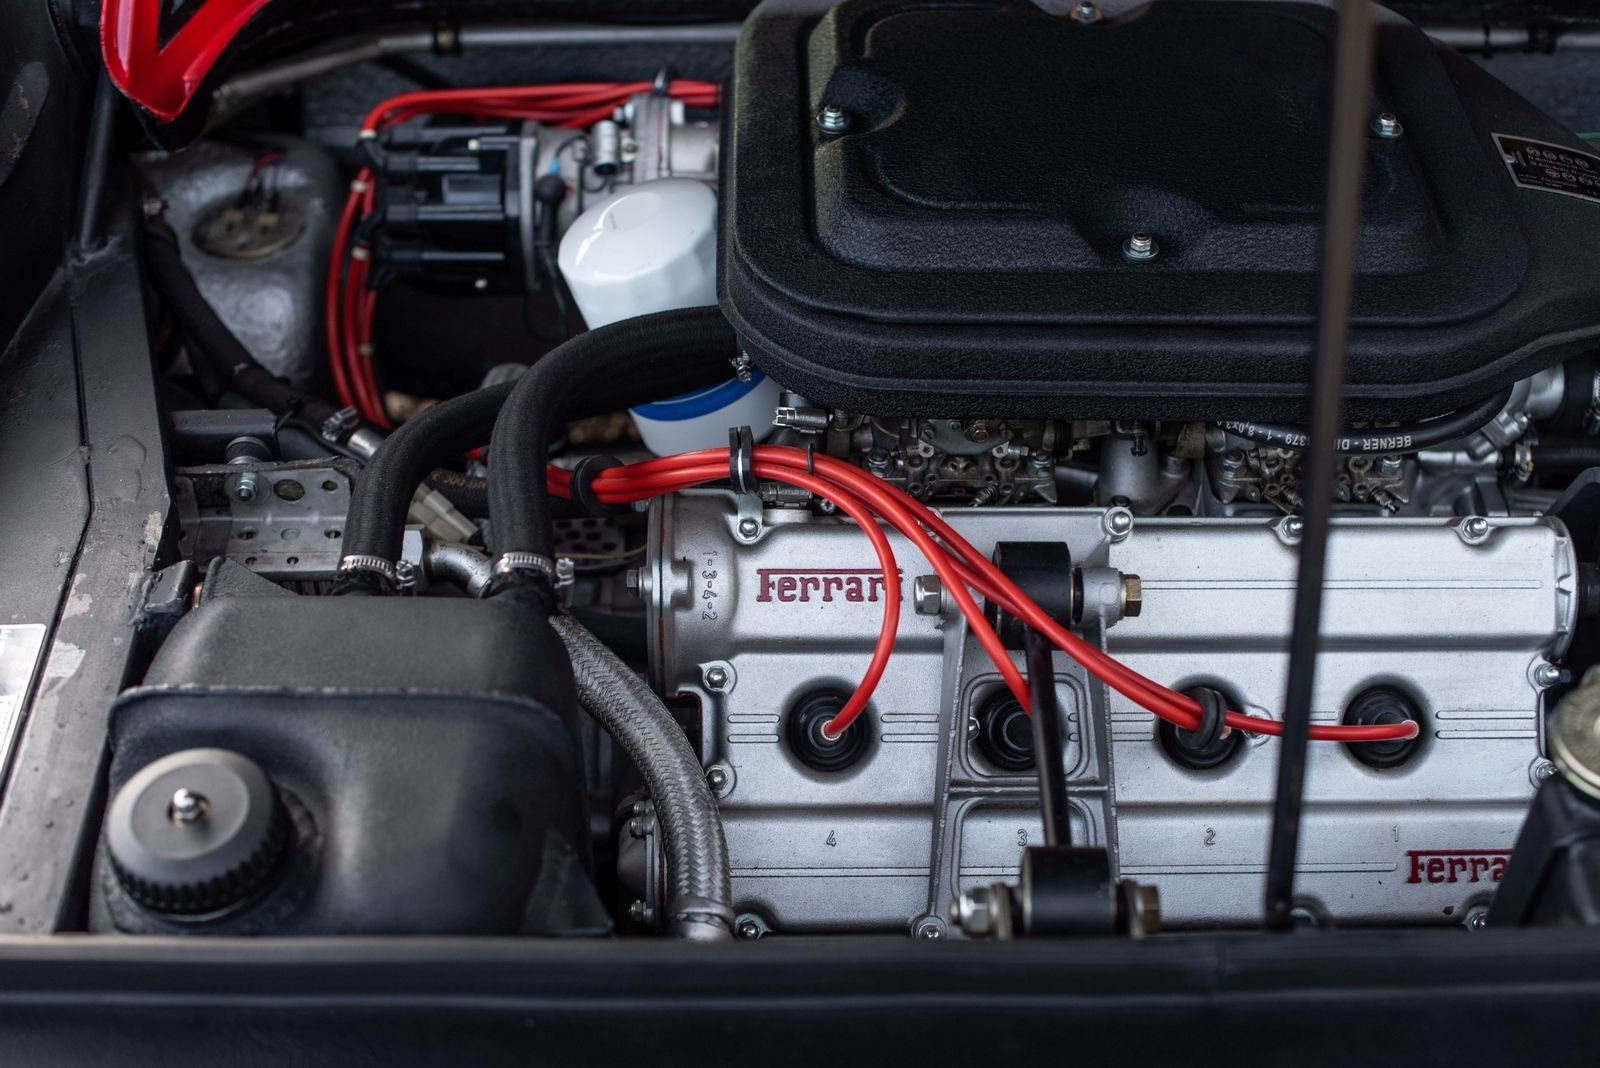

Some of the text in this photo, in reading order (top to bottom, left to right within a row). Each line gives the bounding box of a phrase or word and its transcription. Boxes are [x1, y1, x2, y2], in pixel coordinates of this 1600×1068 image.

[1285, 433, 1310, 447] 379
[1334, 438, 1350, 451] DI
[1363, 435, 1412, 450] BERNER
[756, 568, 903, 603] Ferrar
[826, 830, 837, 847] 4
[1017, 829, 1028, 847] 3
[1204, 828, 1217, 846] 2
[1392, 825, 1399, 843] 1
